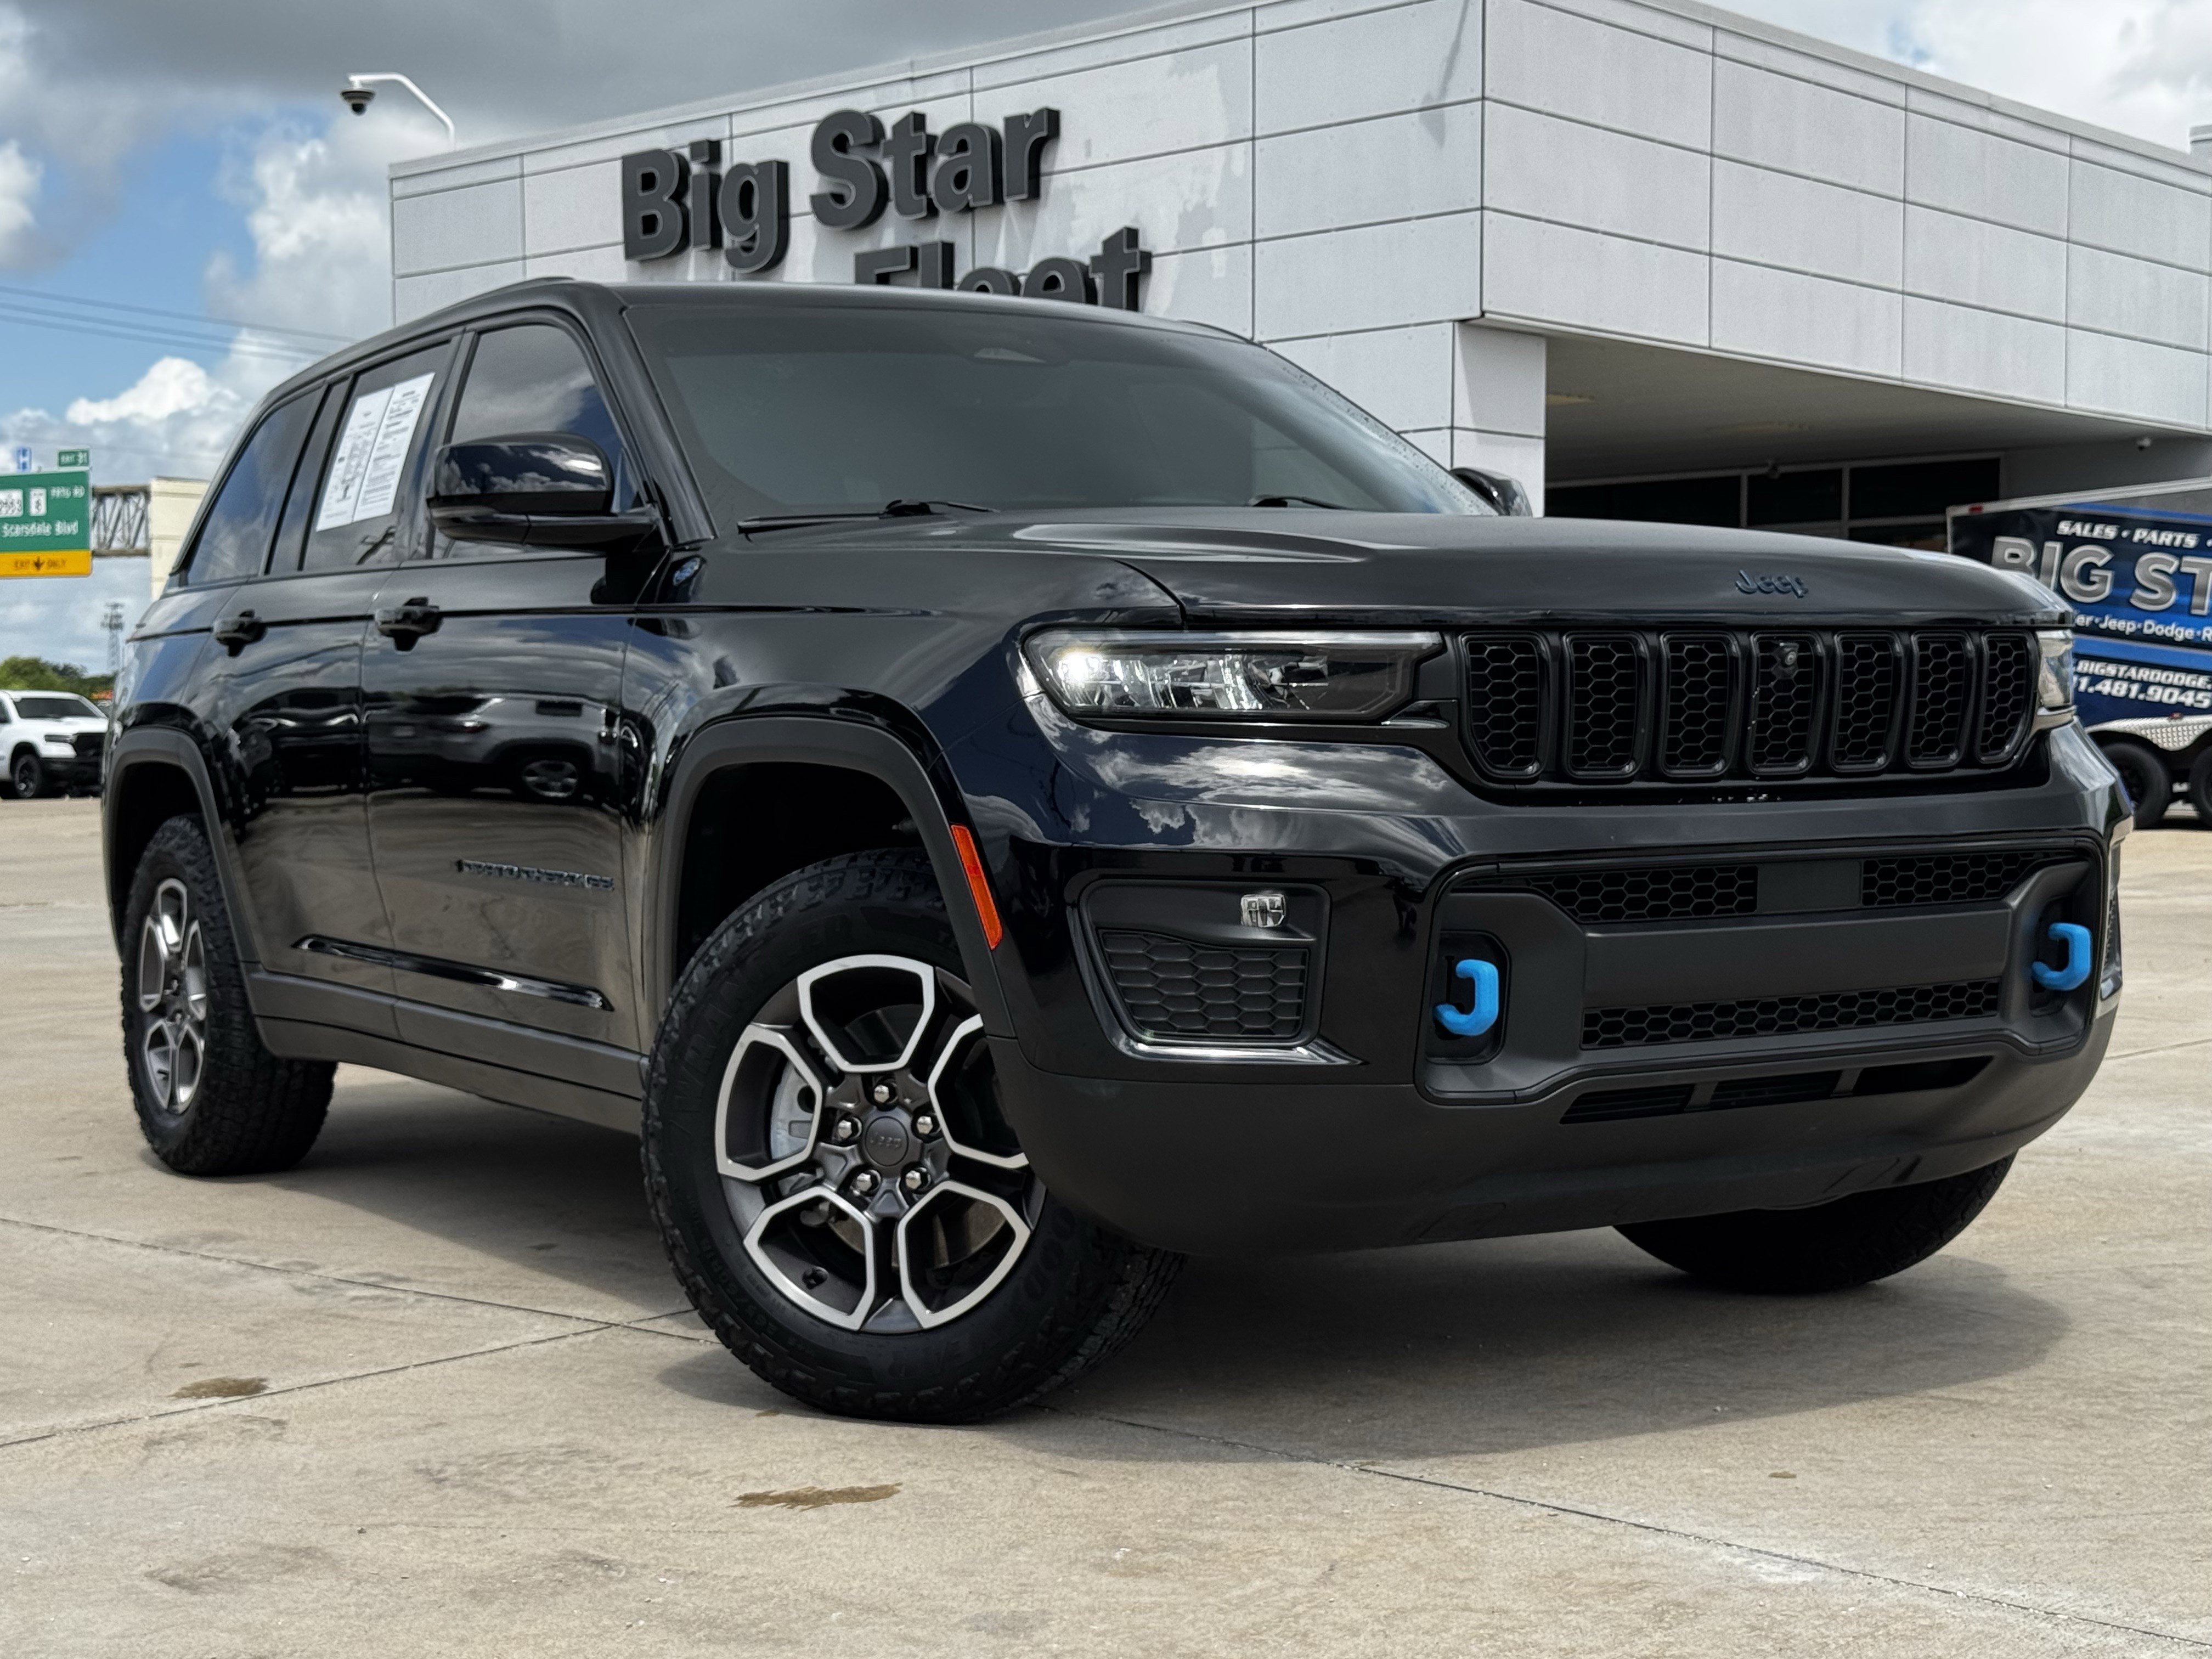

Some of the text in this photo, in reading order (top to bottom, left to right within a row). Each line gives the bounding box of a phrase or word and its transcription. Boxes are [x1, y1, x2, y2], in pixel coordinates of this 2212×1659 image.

[622, 139, 789, 273] Big
[810, 108, 1059, 230] Star
[2057, 520, 2200, 549] SALES PARTS
[1735, 569, 1809, 599] Jeep
[1992, 535, 2115, 603] BIG
